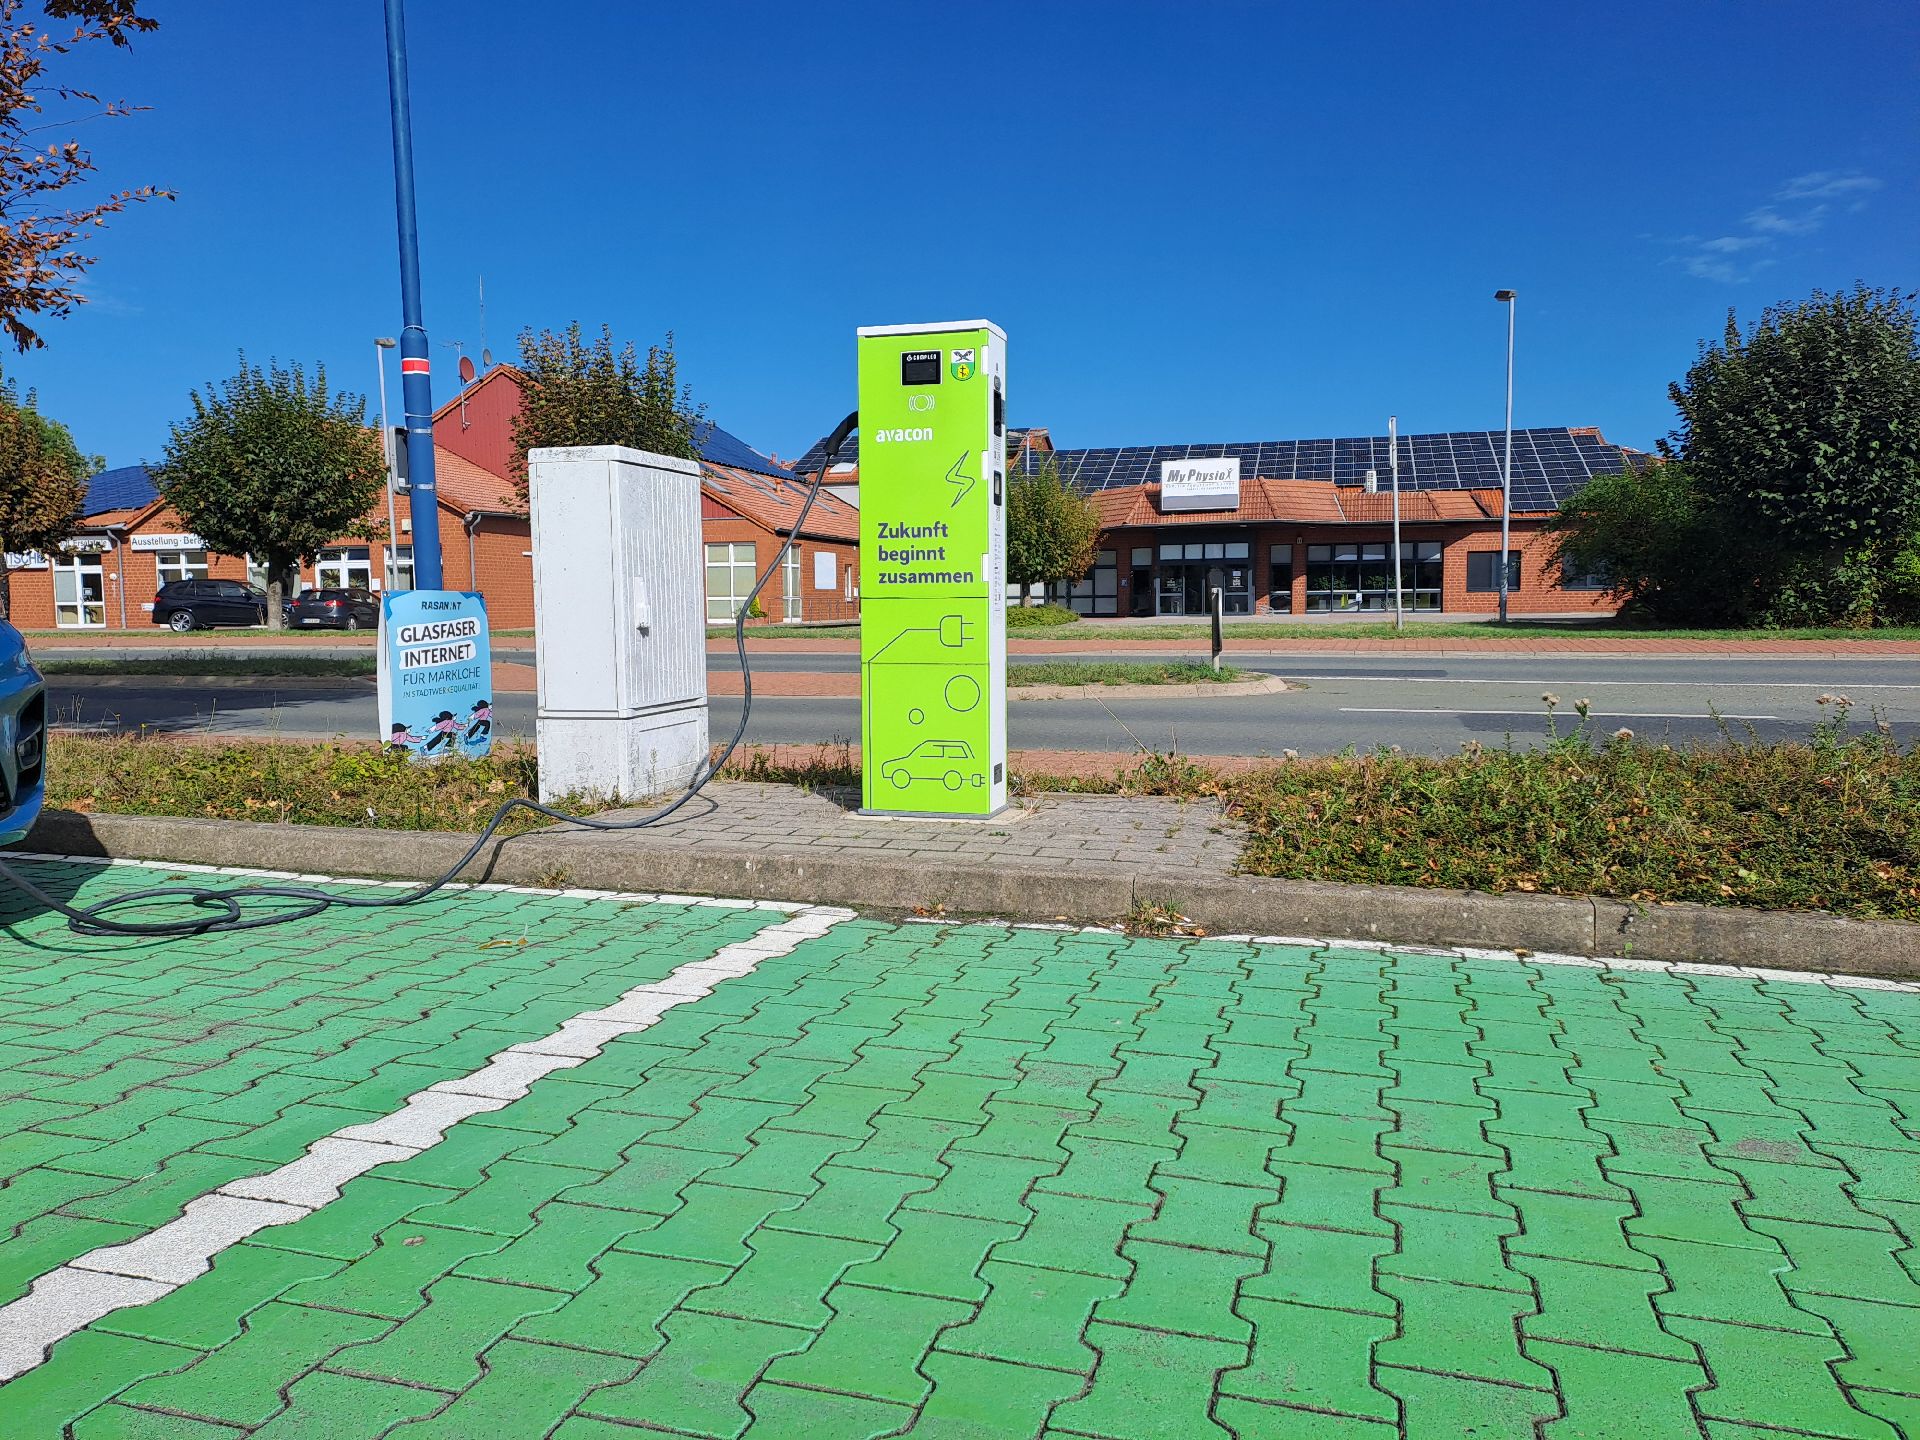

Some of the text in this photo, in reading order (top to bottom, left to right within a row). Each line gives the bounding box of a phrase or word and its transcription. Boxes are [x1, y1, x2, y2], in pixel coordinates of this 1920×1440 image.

[876, 427, 933, 443] avacon
[1167, 469, 1186, 483] My
[877, 520, 949, 539] Zukunft
[131, 536, 179, 547] Ausstellung
[878, 544, 946, 566] beginnt
[878, 571, 974, 585] zusammen
[400, 620, 477, 643] GLASFASER
[404, 643, 472, 668] INTERNET
[402, 671, 426, 686] FÜR
